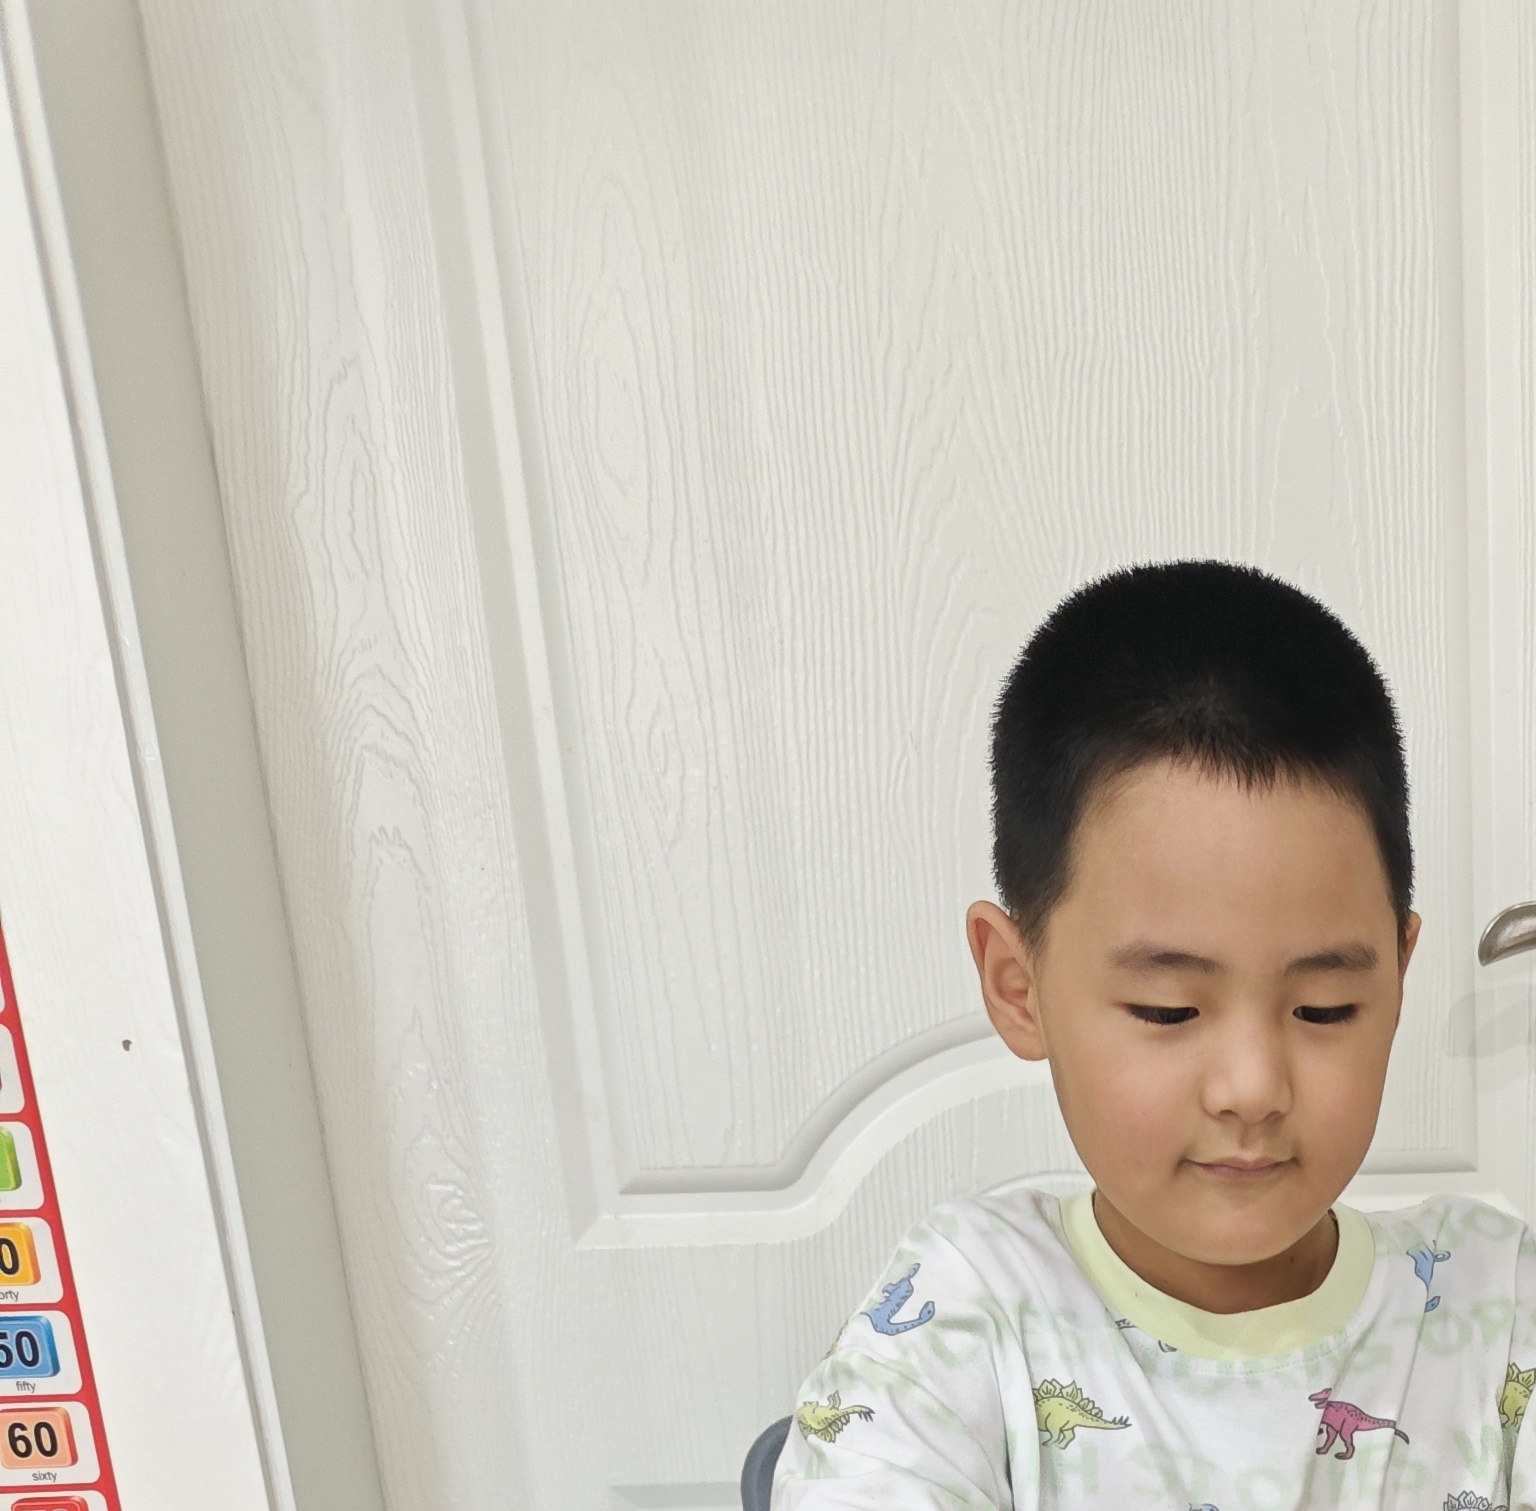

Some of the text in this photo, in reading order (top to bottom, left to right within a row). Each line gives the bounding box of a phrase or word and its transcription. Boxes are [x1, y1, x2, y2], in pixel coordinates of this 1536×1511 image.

[0, 1238, 20, 1275] 0
[0, 1290, 19, 1302] orty
[16, 1381, 36, 1393] fifty
[7, 1421, 58, 1459] 60
[32, 1470, 57, 1483] sixty
